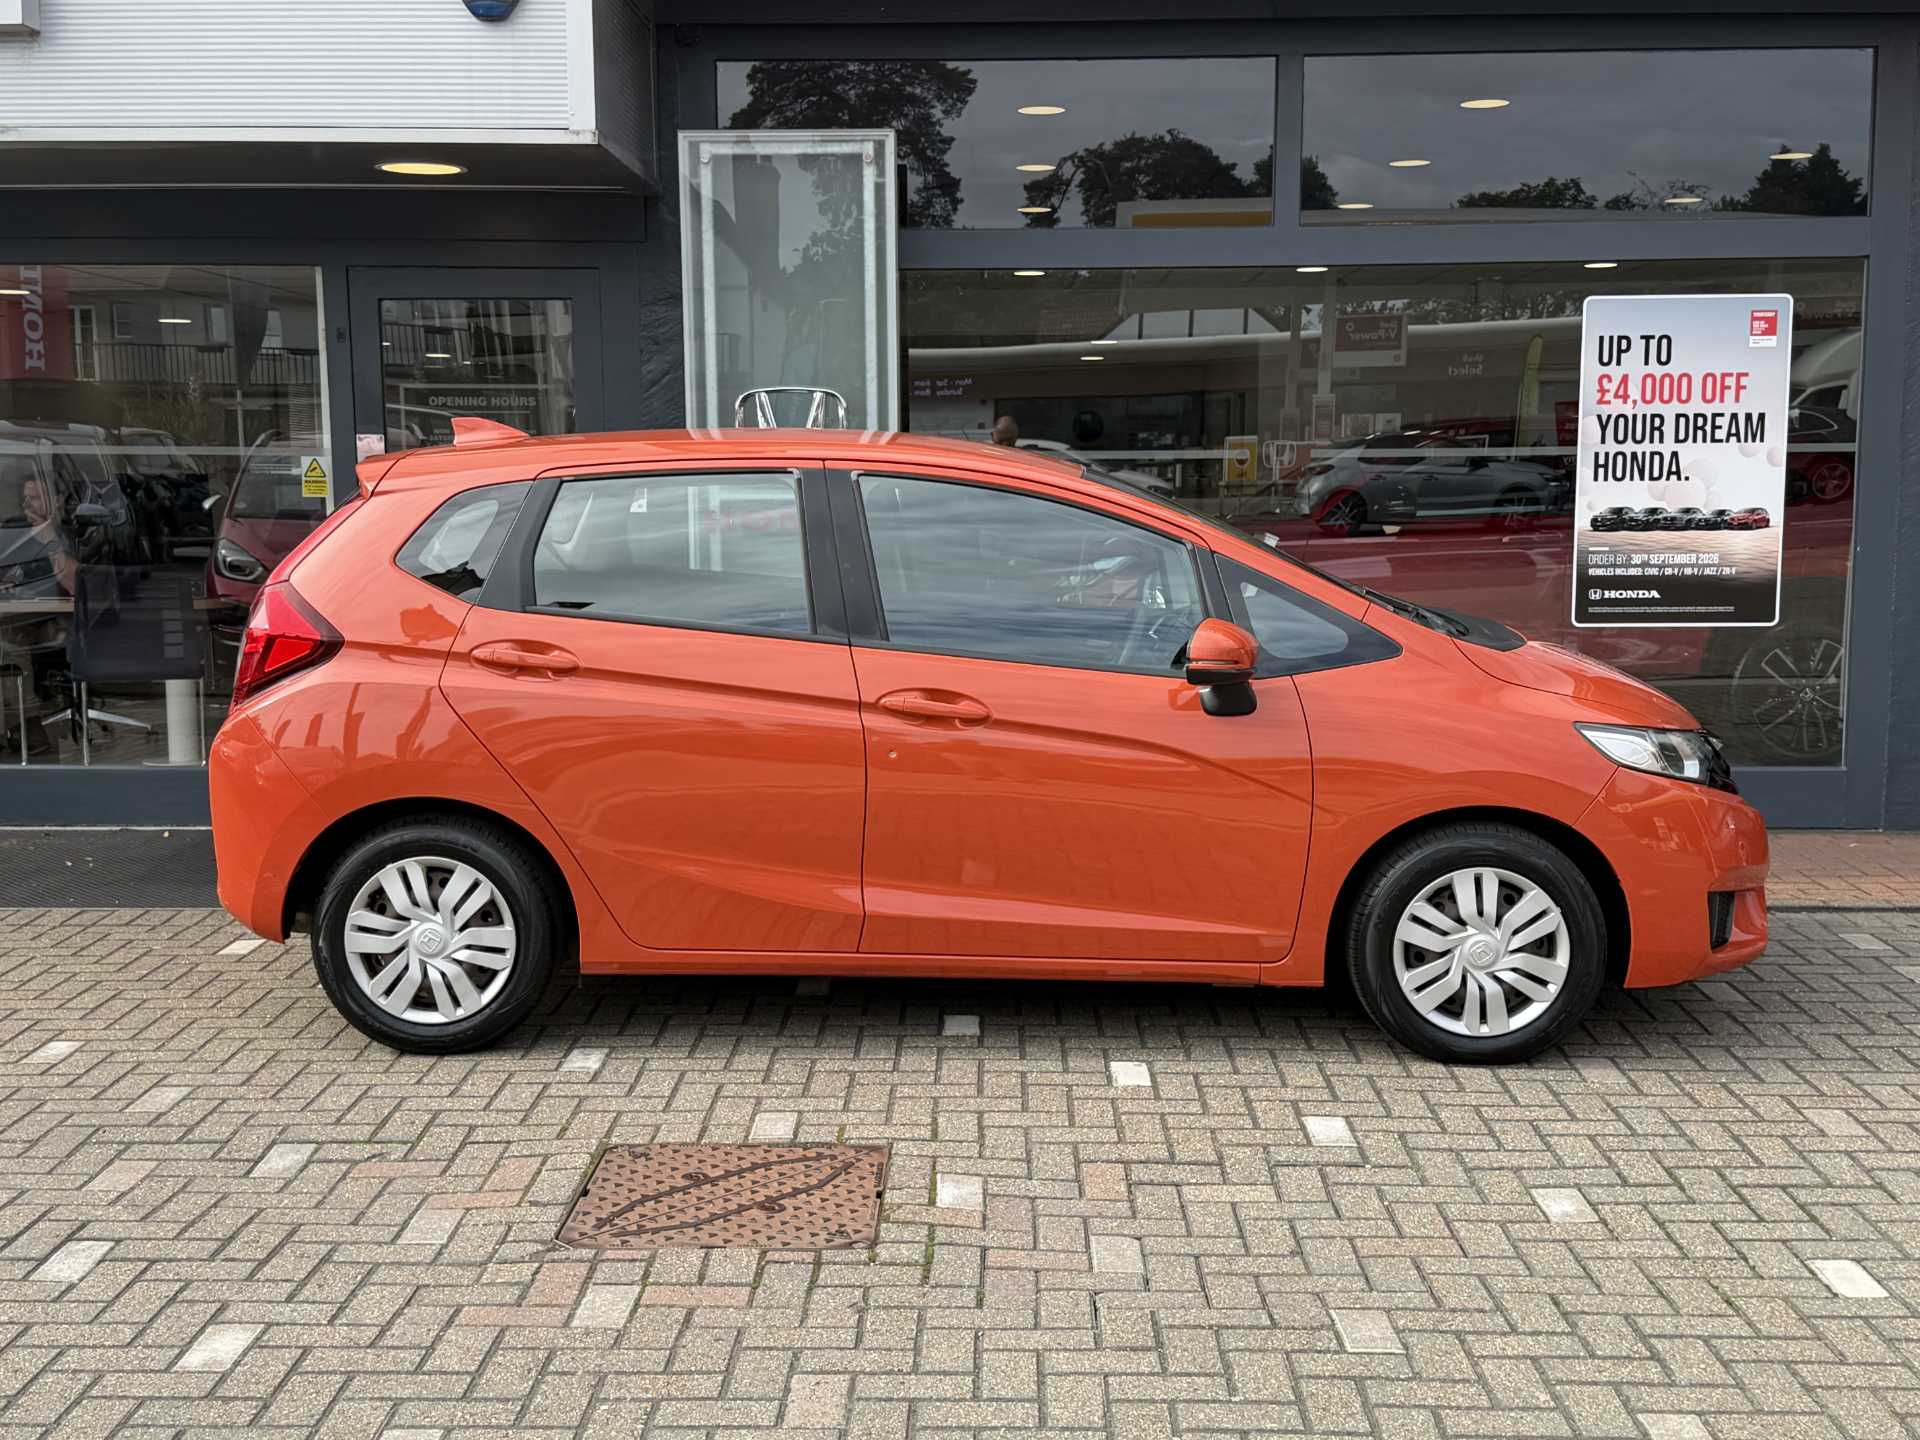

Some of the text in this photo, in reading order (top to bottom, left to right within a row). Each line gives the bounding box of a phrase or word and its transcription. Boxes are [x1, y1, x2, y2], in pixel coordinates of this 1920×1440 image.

[1598, 334, 1672, 366] UP TO
[1596, 372, 1749, 409] £4,000 OFF
[428, 396, 537, 407] OPENING HOURS
[1597, 413, 1664, 445] YOUR
[1674, 412, 1766, 443] DREAM
[1593, 451, 1690, 482] HONDA.
[1588, 554, 1614, 565] ORDER
[1649, 553, 1696, 564] SEPTEMBER
[1588, 568, 1614, 576] VEHICLES
[1603, 590, 1661, 599] HONDA
